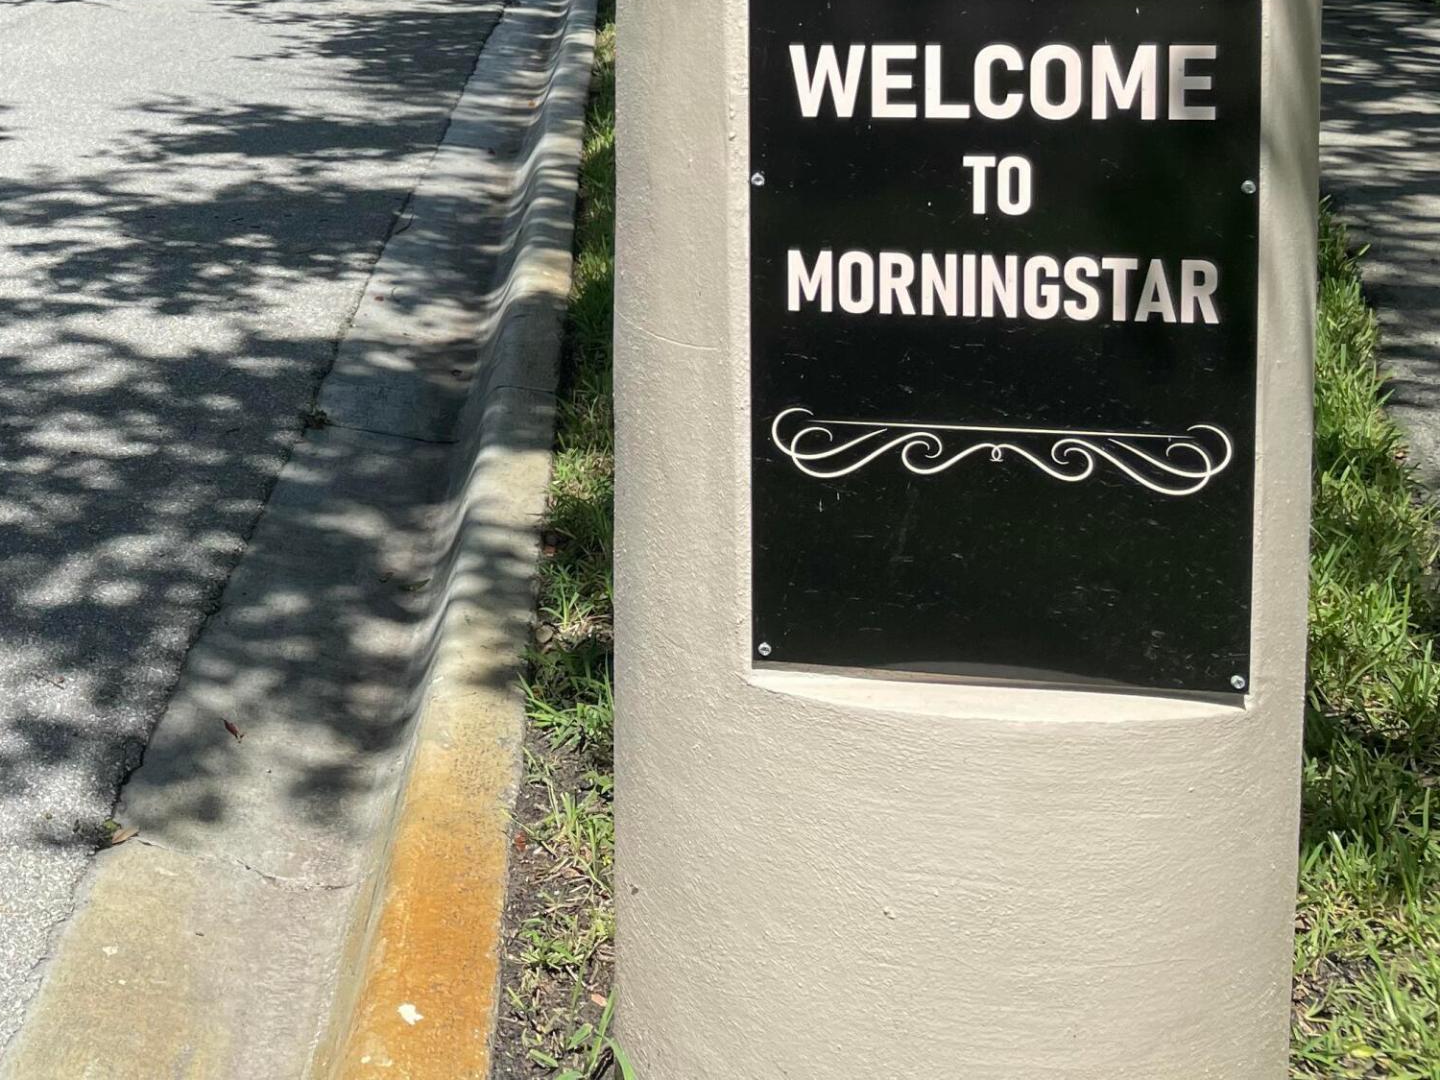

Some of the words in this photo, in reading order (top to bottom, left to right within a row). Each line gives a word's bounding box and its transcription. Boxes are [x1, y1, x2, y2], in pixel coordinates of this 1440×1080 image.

[788, 43, 1217, 121] WELCOME
[962, 155, 1032, 216] TO
[786, 248, 1220, 324] MORNINGSTAR
